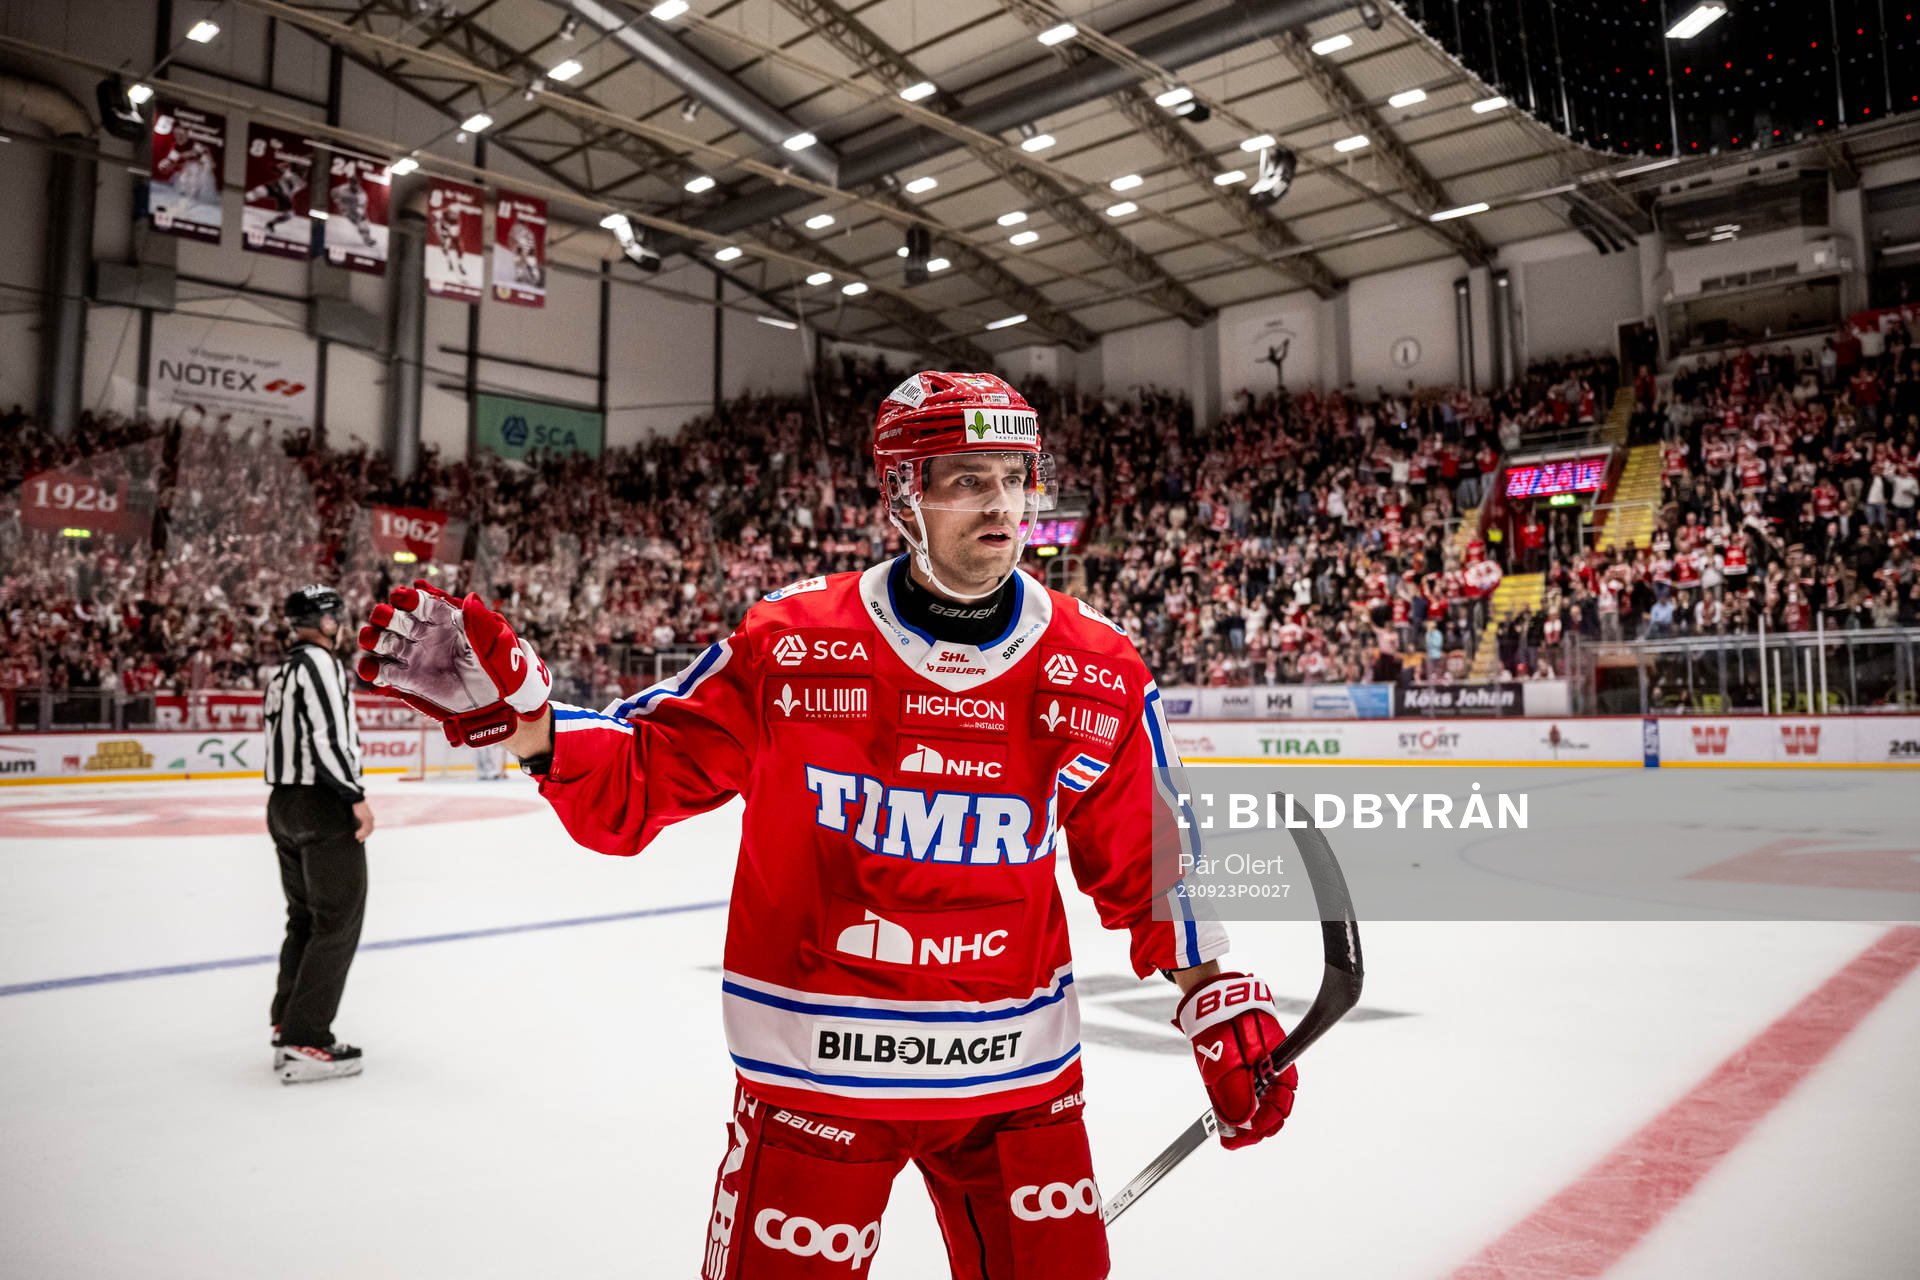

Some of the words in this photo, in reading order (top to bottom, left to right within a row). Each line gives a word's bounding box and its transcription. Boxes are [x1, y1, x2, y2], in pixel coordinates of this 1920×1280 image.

[331, 158, 356, 178] 24
[158, 359, 257, 393] NOTEX
[534, 424, 578, 448] SCA
[993, 415, 1036, 437] LILIUM
[33, 480, 118, 512] 1928
[381, 512, 440, 545] 1962
[813, 640, 869, 661] SCA
[939, 651, 970, 663] SHL
[935, 666, 986, 676] BAUER
[1083, 664, 1126, 695] SCA
[805, 688, 867, 712] LILIUM
[906, 694, 1005, 721] HIGHCON
[1455, 690, 1515, 707] Johan
[469, 724, 508, 741] BAUER
[975, 722, 1005, 731] INSTALCO
[1070, 706, 1120, 741] LILIUM
[1259, 739, 1341, 755] TIRAB
[946, 759, 1003, 779] NHC
[919, 929, 1009, 965] NHC
[818, 1031, 1023, 1065] BILBOLAGET
[772, 1109, 856, 1146] BAUER
[754, 1207, 881, 1271] coop
